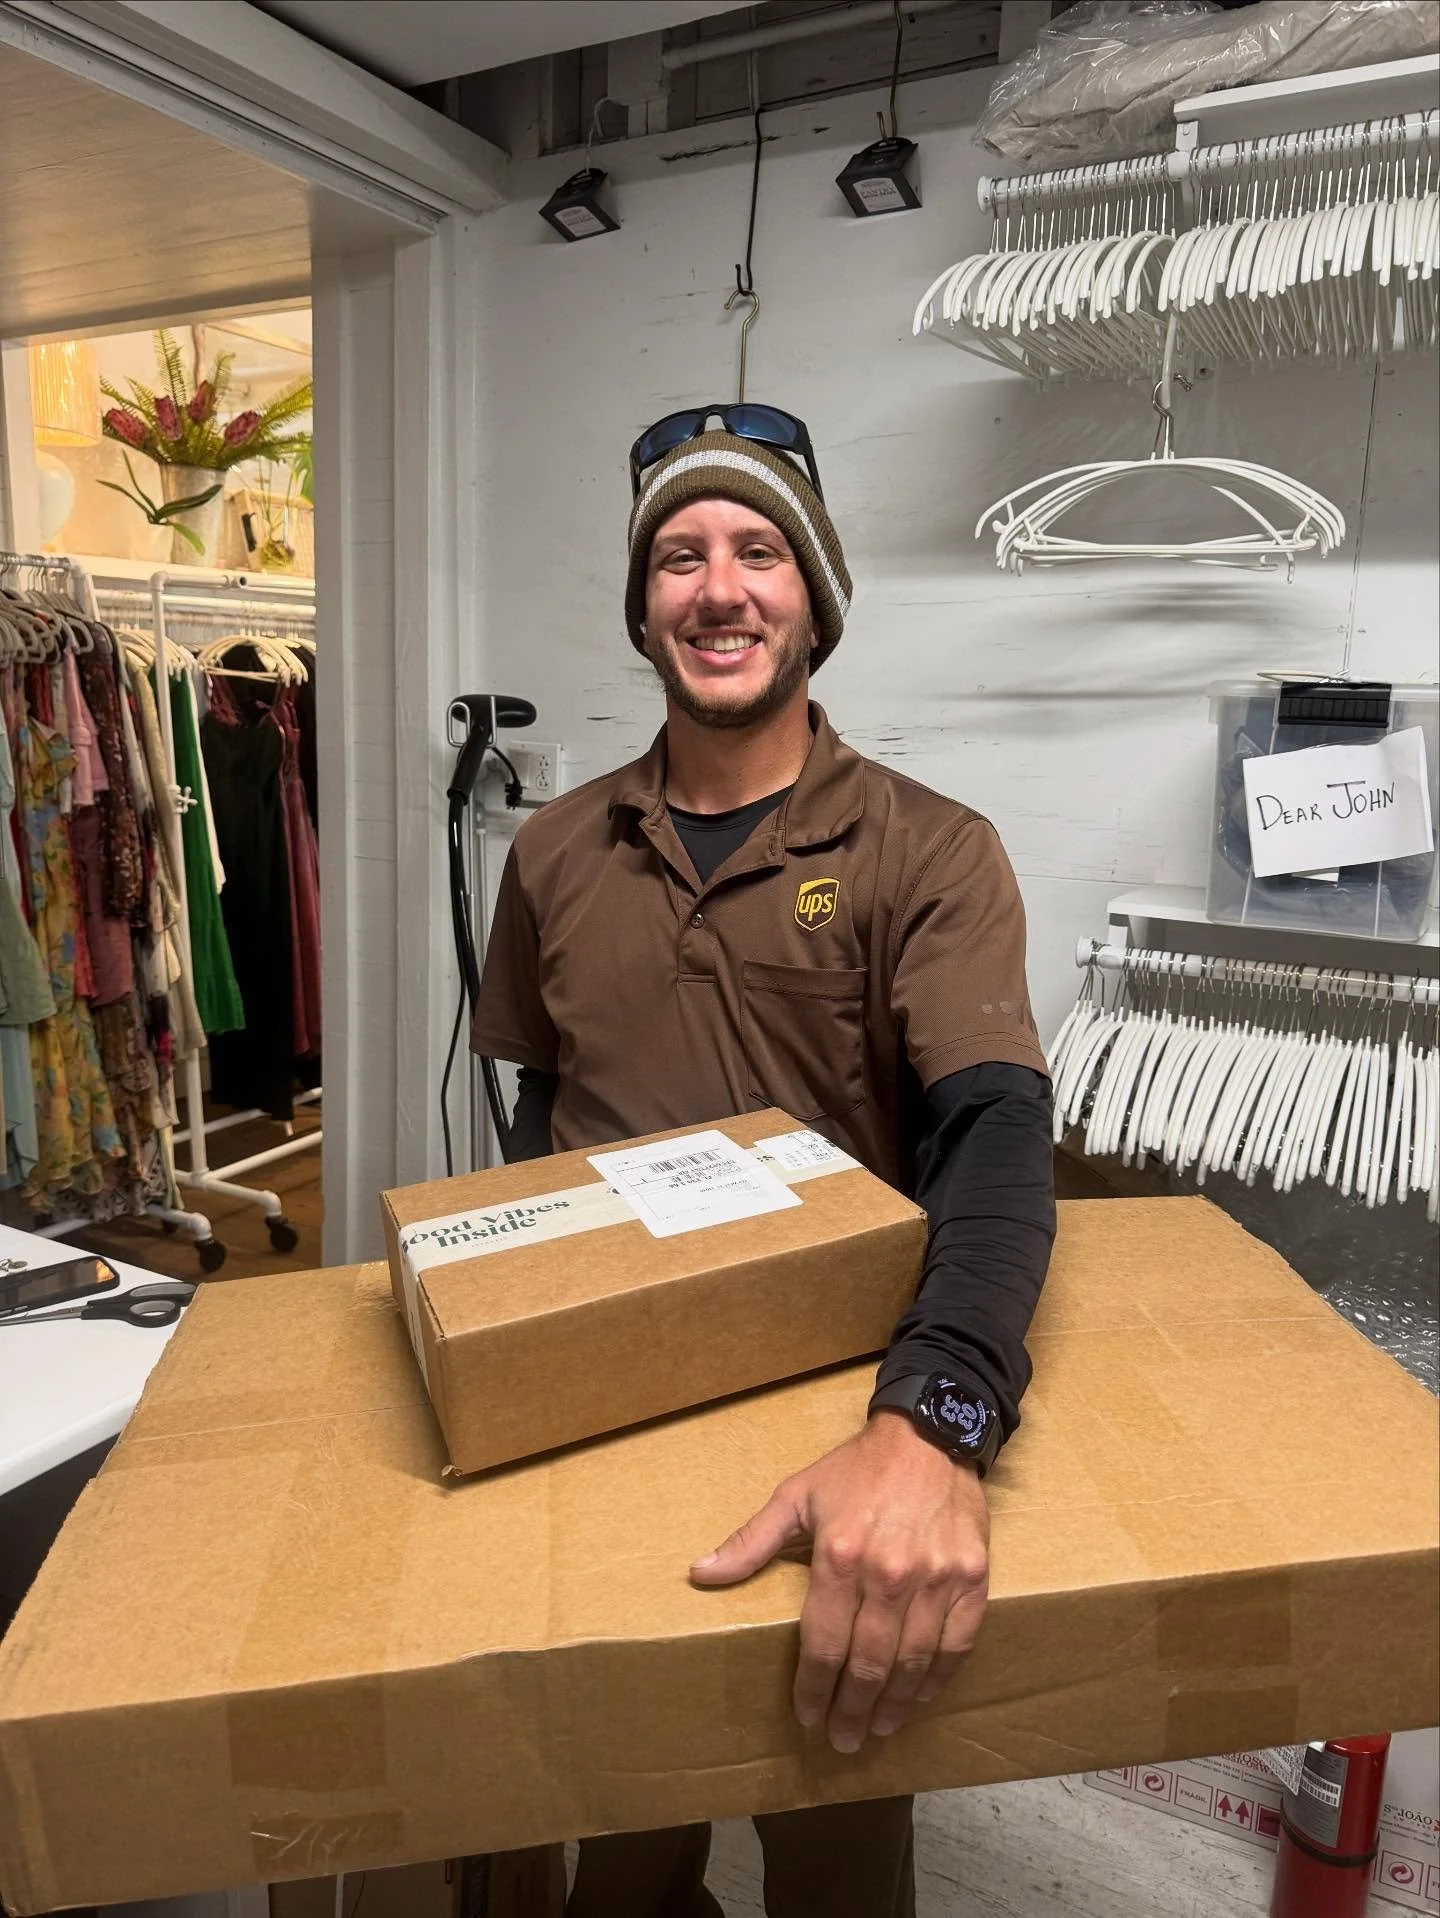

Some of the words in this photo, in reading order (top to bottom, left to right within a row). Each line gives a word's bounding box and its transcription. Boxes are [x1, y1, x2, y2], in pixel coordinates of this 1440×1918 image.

[1256, 795, 1322, 830] DEAR
[1327, 780, 1395, 819] JOHN
[798, 893, 833, 921] ups
[480, 1200, 571, 1224] Vibes
[437, 1218, 537, 1248] Inside
[940, 1394, 961, 1422] 53
[958, 1403, 978, 1430] 03
